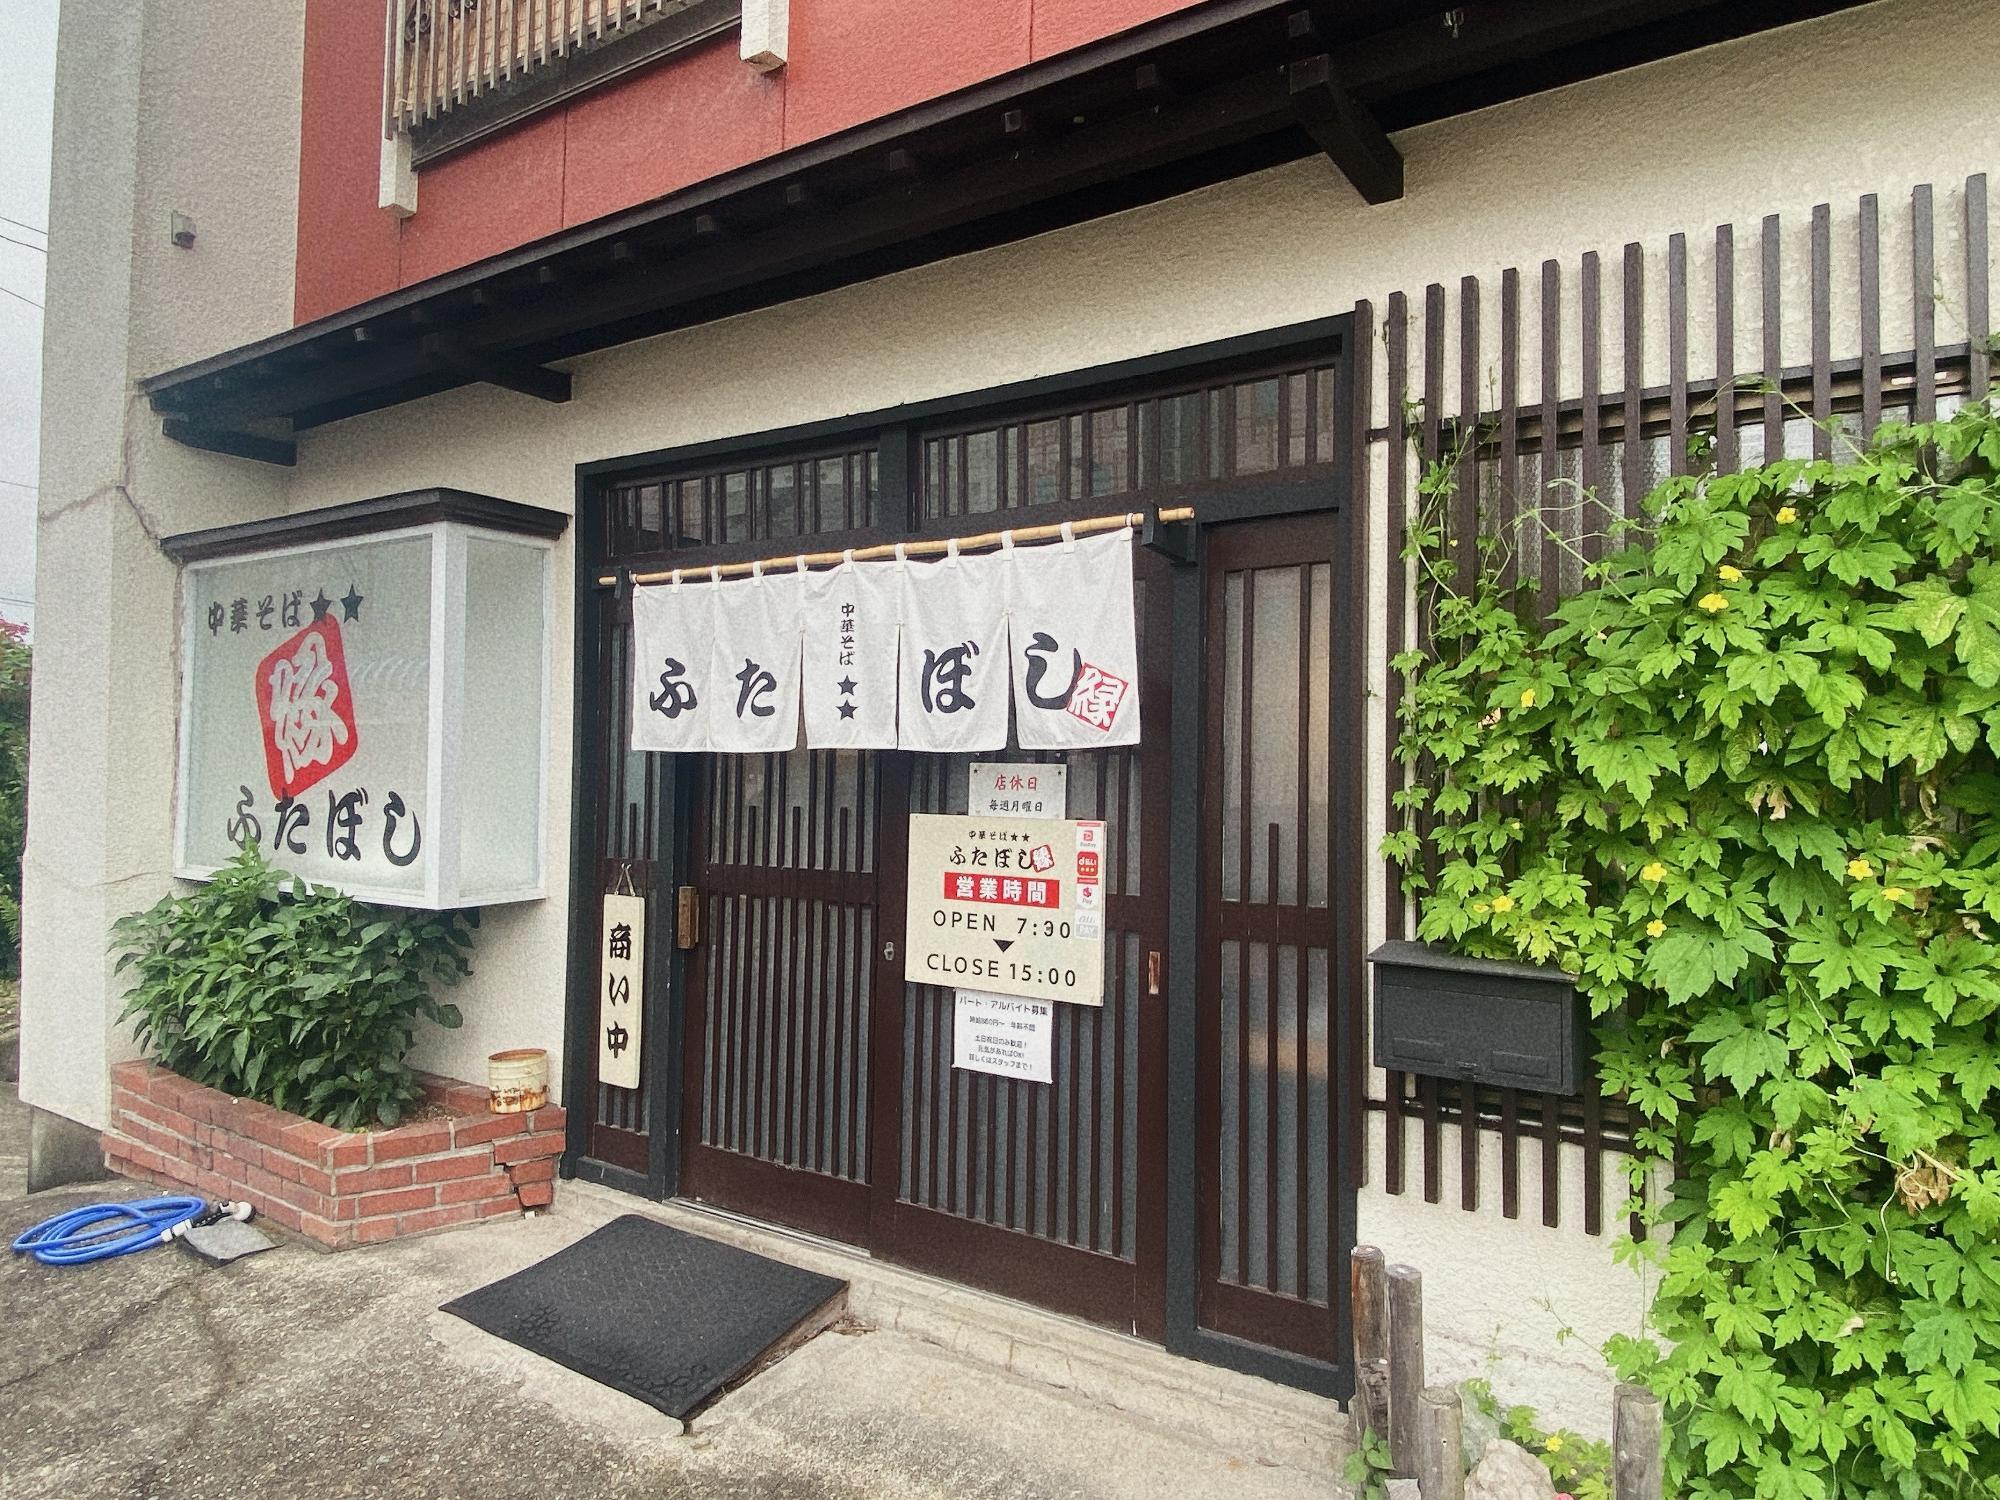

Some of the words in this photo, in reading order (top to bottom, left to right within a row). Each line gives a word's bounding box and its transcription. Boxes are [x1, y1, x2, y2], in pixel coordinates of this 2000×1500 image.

[208, 590, 303, 636] 中華そば
[838, 602, 856, 666] 中華そば
[994, 773, 1038, 792] 店休日
[989, 799, 1043, 813] 毎週月曜日
[227, 784, 422, 867] ふたぼし
[968, 830, 1008, 841] 中華そば
[949, 845, 1034, 870] ふたぼし
[956, 875, 1047, 905] 営業時間
[933, 909, 996, 932] OPEN
[1016, 916, 1071, 939] 7:30
[926, 953, 999, 978] CLOSE
[1009, 962, 1076, 987] 15:00
[606, 921, 632, 1059] 商い中
